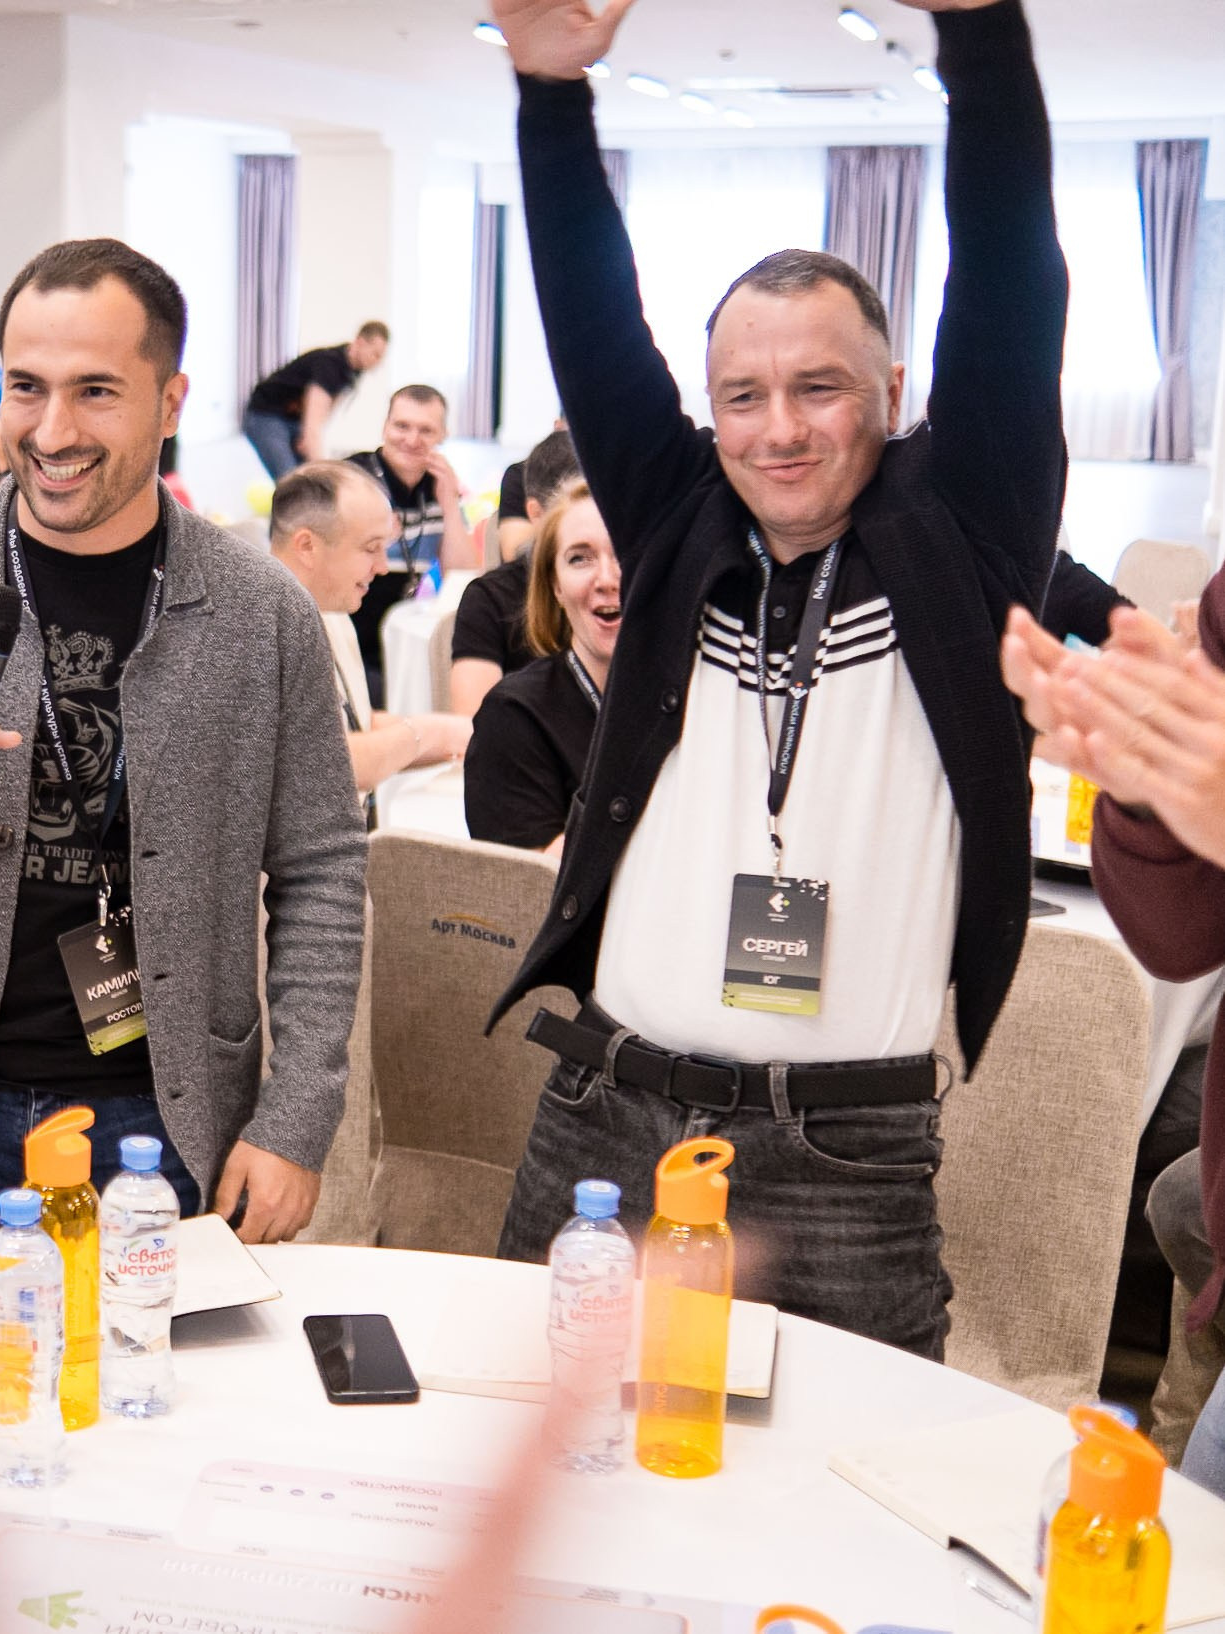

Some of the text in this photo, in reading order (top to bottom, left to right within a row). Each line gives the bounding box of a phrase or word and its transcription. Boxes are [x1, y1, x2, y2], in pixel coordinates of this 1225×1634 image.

[8, 528, 18, 548] Мы
[11, 550, 28, 597] создаем
[812, 579, 828, 600] Мы
[41, 687, 60, 739] культуры
[54, 741, 73, 782] успеха
[53, 858, 128, 885] JEAN
[431, 918, 516, 949] Арт Москва
[742, 937, 809, 957] СЕРГЕЙ
[763, 975, 782, 985] ЮГ
